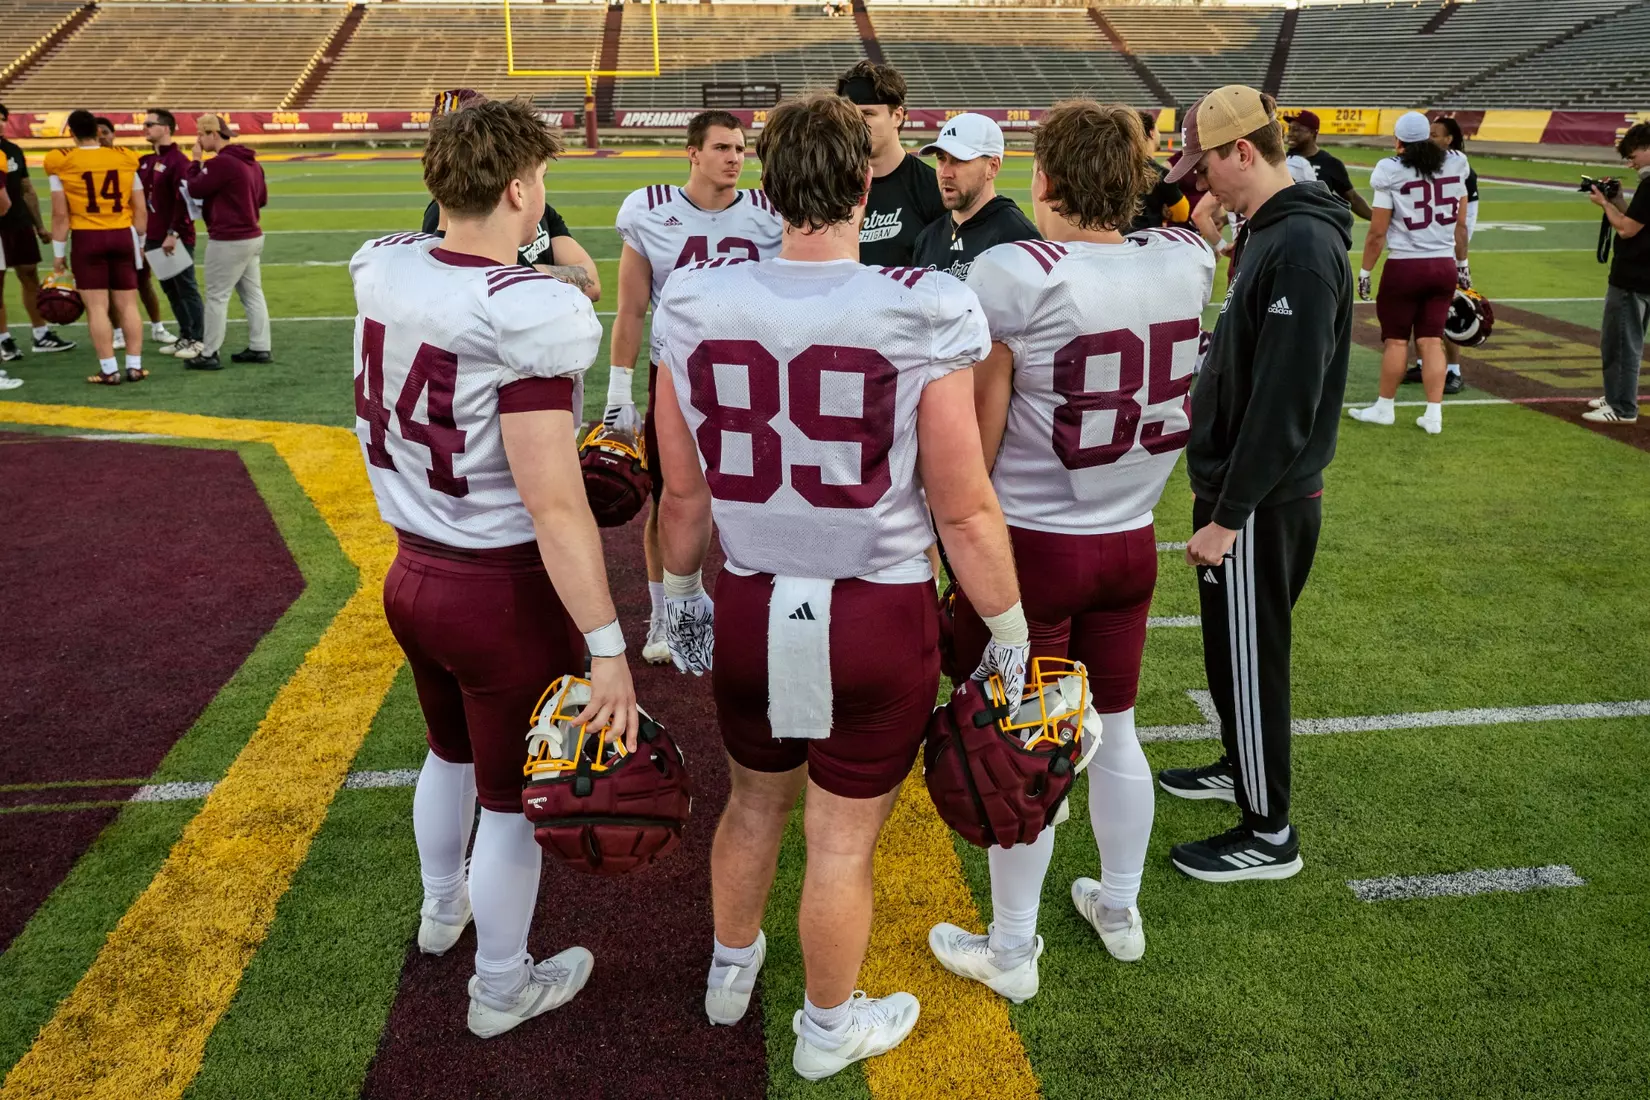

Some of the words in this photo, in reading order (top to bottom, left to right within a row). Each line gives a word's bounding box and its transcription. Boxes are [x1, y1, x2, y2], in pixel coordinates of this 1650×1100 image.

[410, 111, 431, 123] 200
[541, 112, 564, 126] OWL
[1336, 109, 1362, 120] 2021
[81, 169, 123, 213] 14
[1400, 176, 1460, 231] 35
[863, 207, 902, 229] ntral
[859, 228, 892, 241] HIGAN
[1267, 306, 1293, 315] adidas
[1052, 317, 1200, 471] 85
[354, 316, 470, 498] 44
[686, 339, 899, 509] 89
